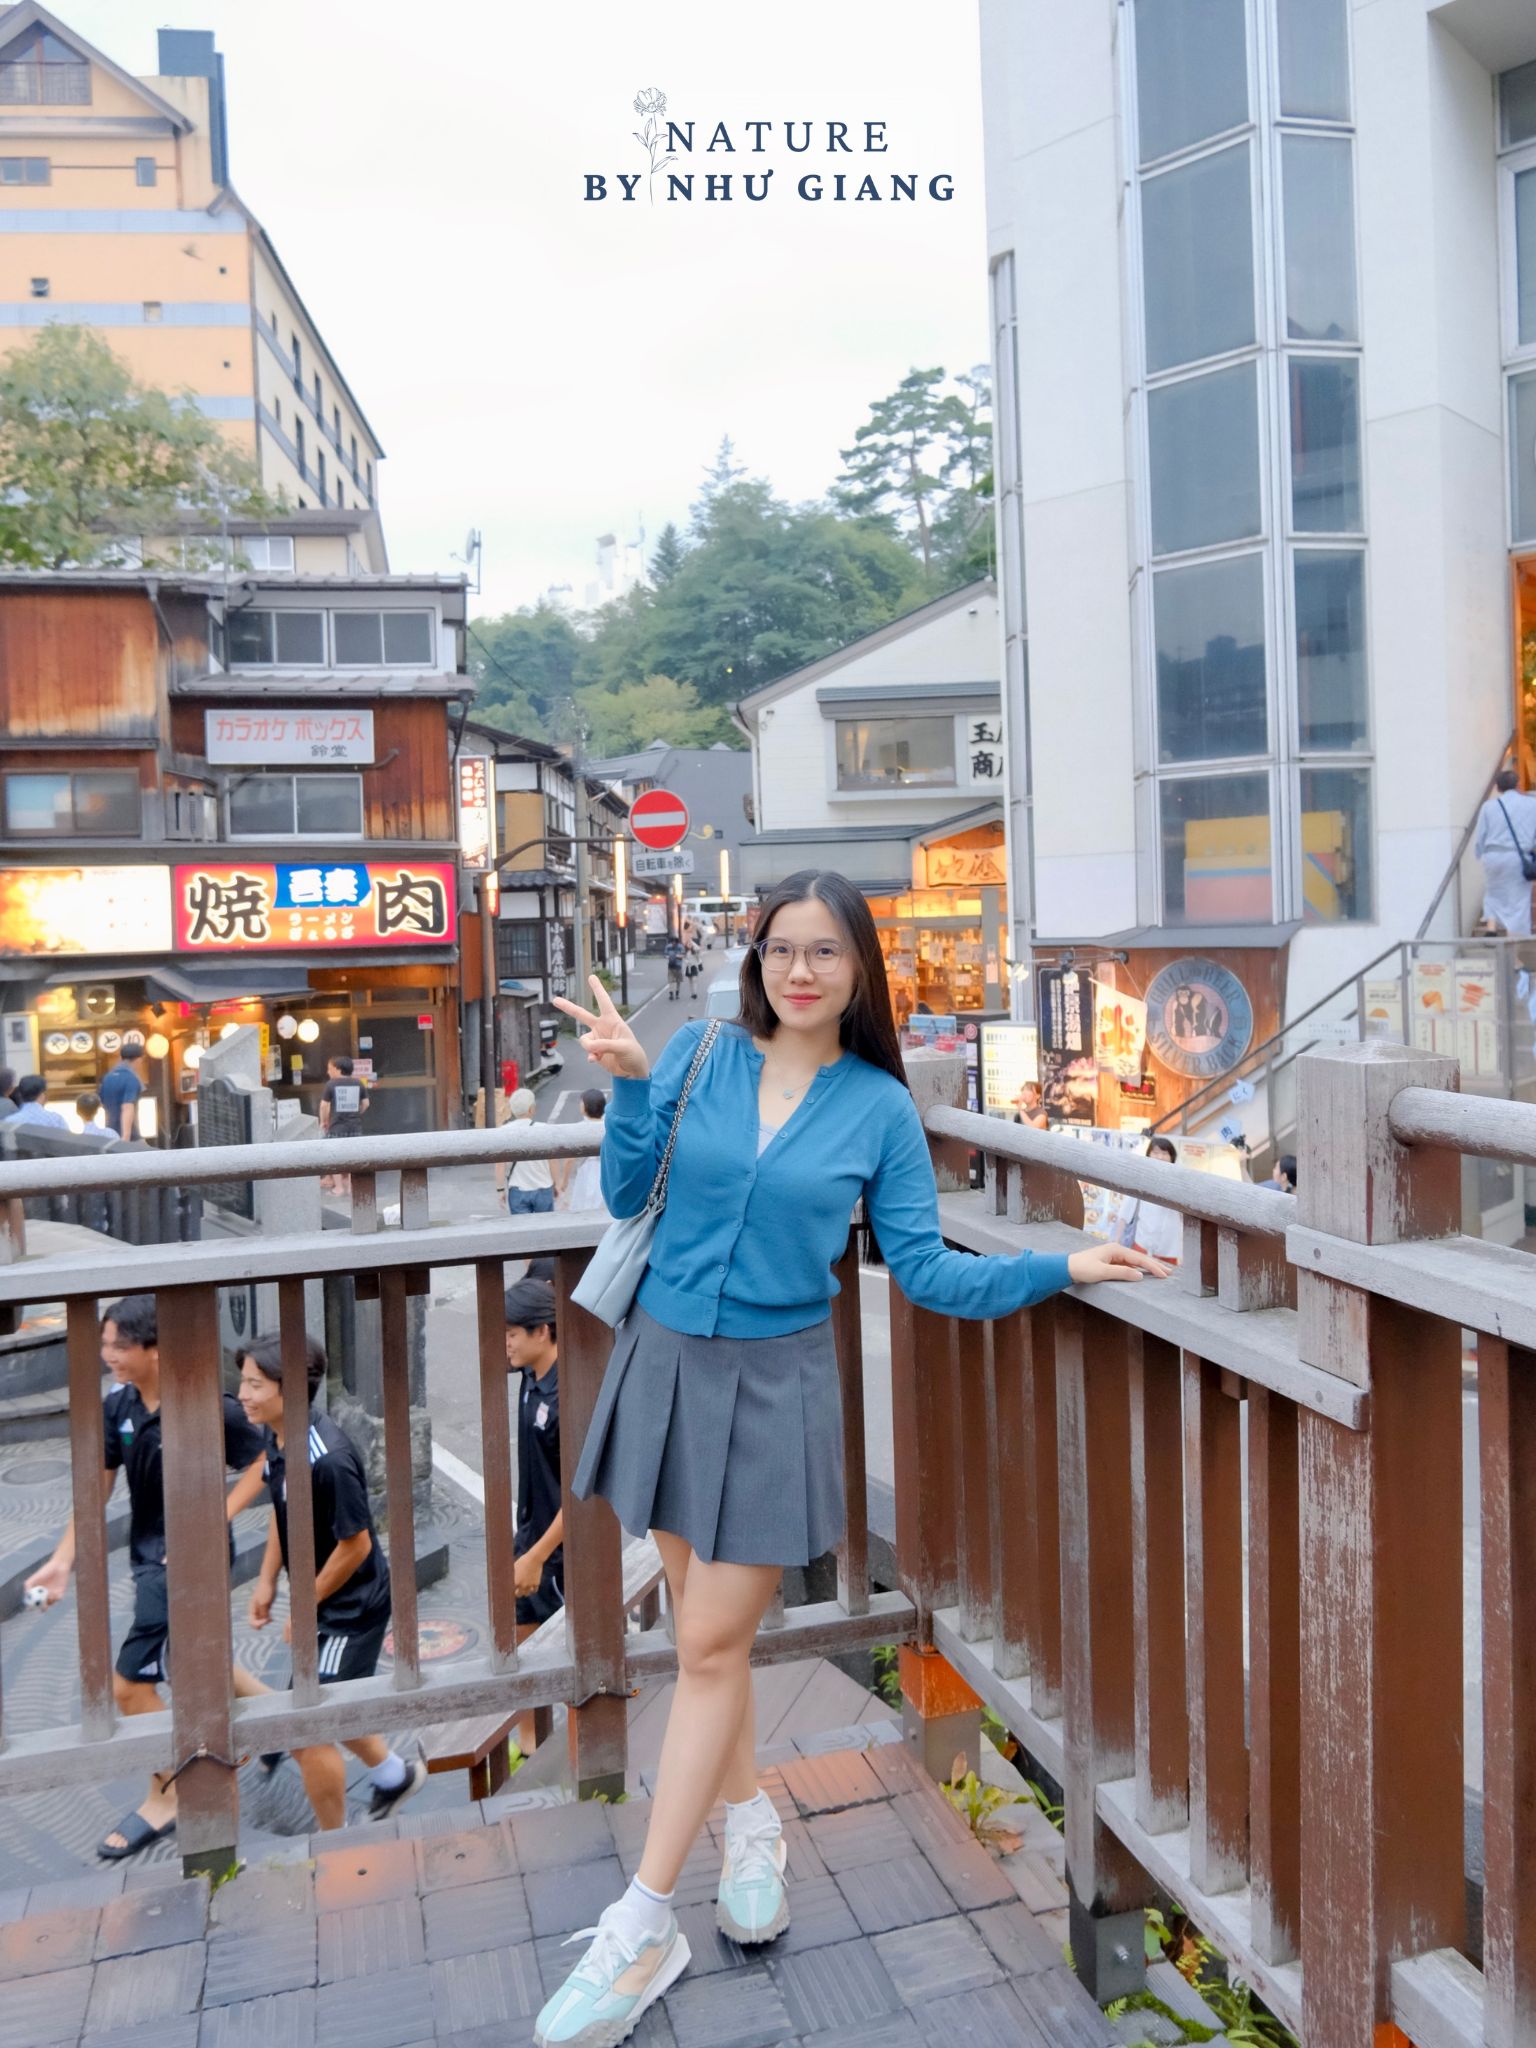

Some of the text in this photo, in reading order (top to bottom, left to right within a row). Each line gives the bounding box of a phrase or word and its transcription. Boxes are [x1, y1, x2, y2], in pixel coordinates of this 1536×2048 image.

[215, 717, 365, 742] カラオケ ボックス
[969, 721, 1003, 745] 玉
[971, 750, 1004, 779] 商
[636, 855, 690, 871] 自転車を除く
[289, 912, 353, 927] ラーメン
[1151, 1031, 1244, 1074] SILVER BACK
